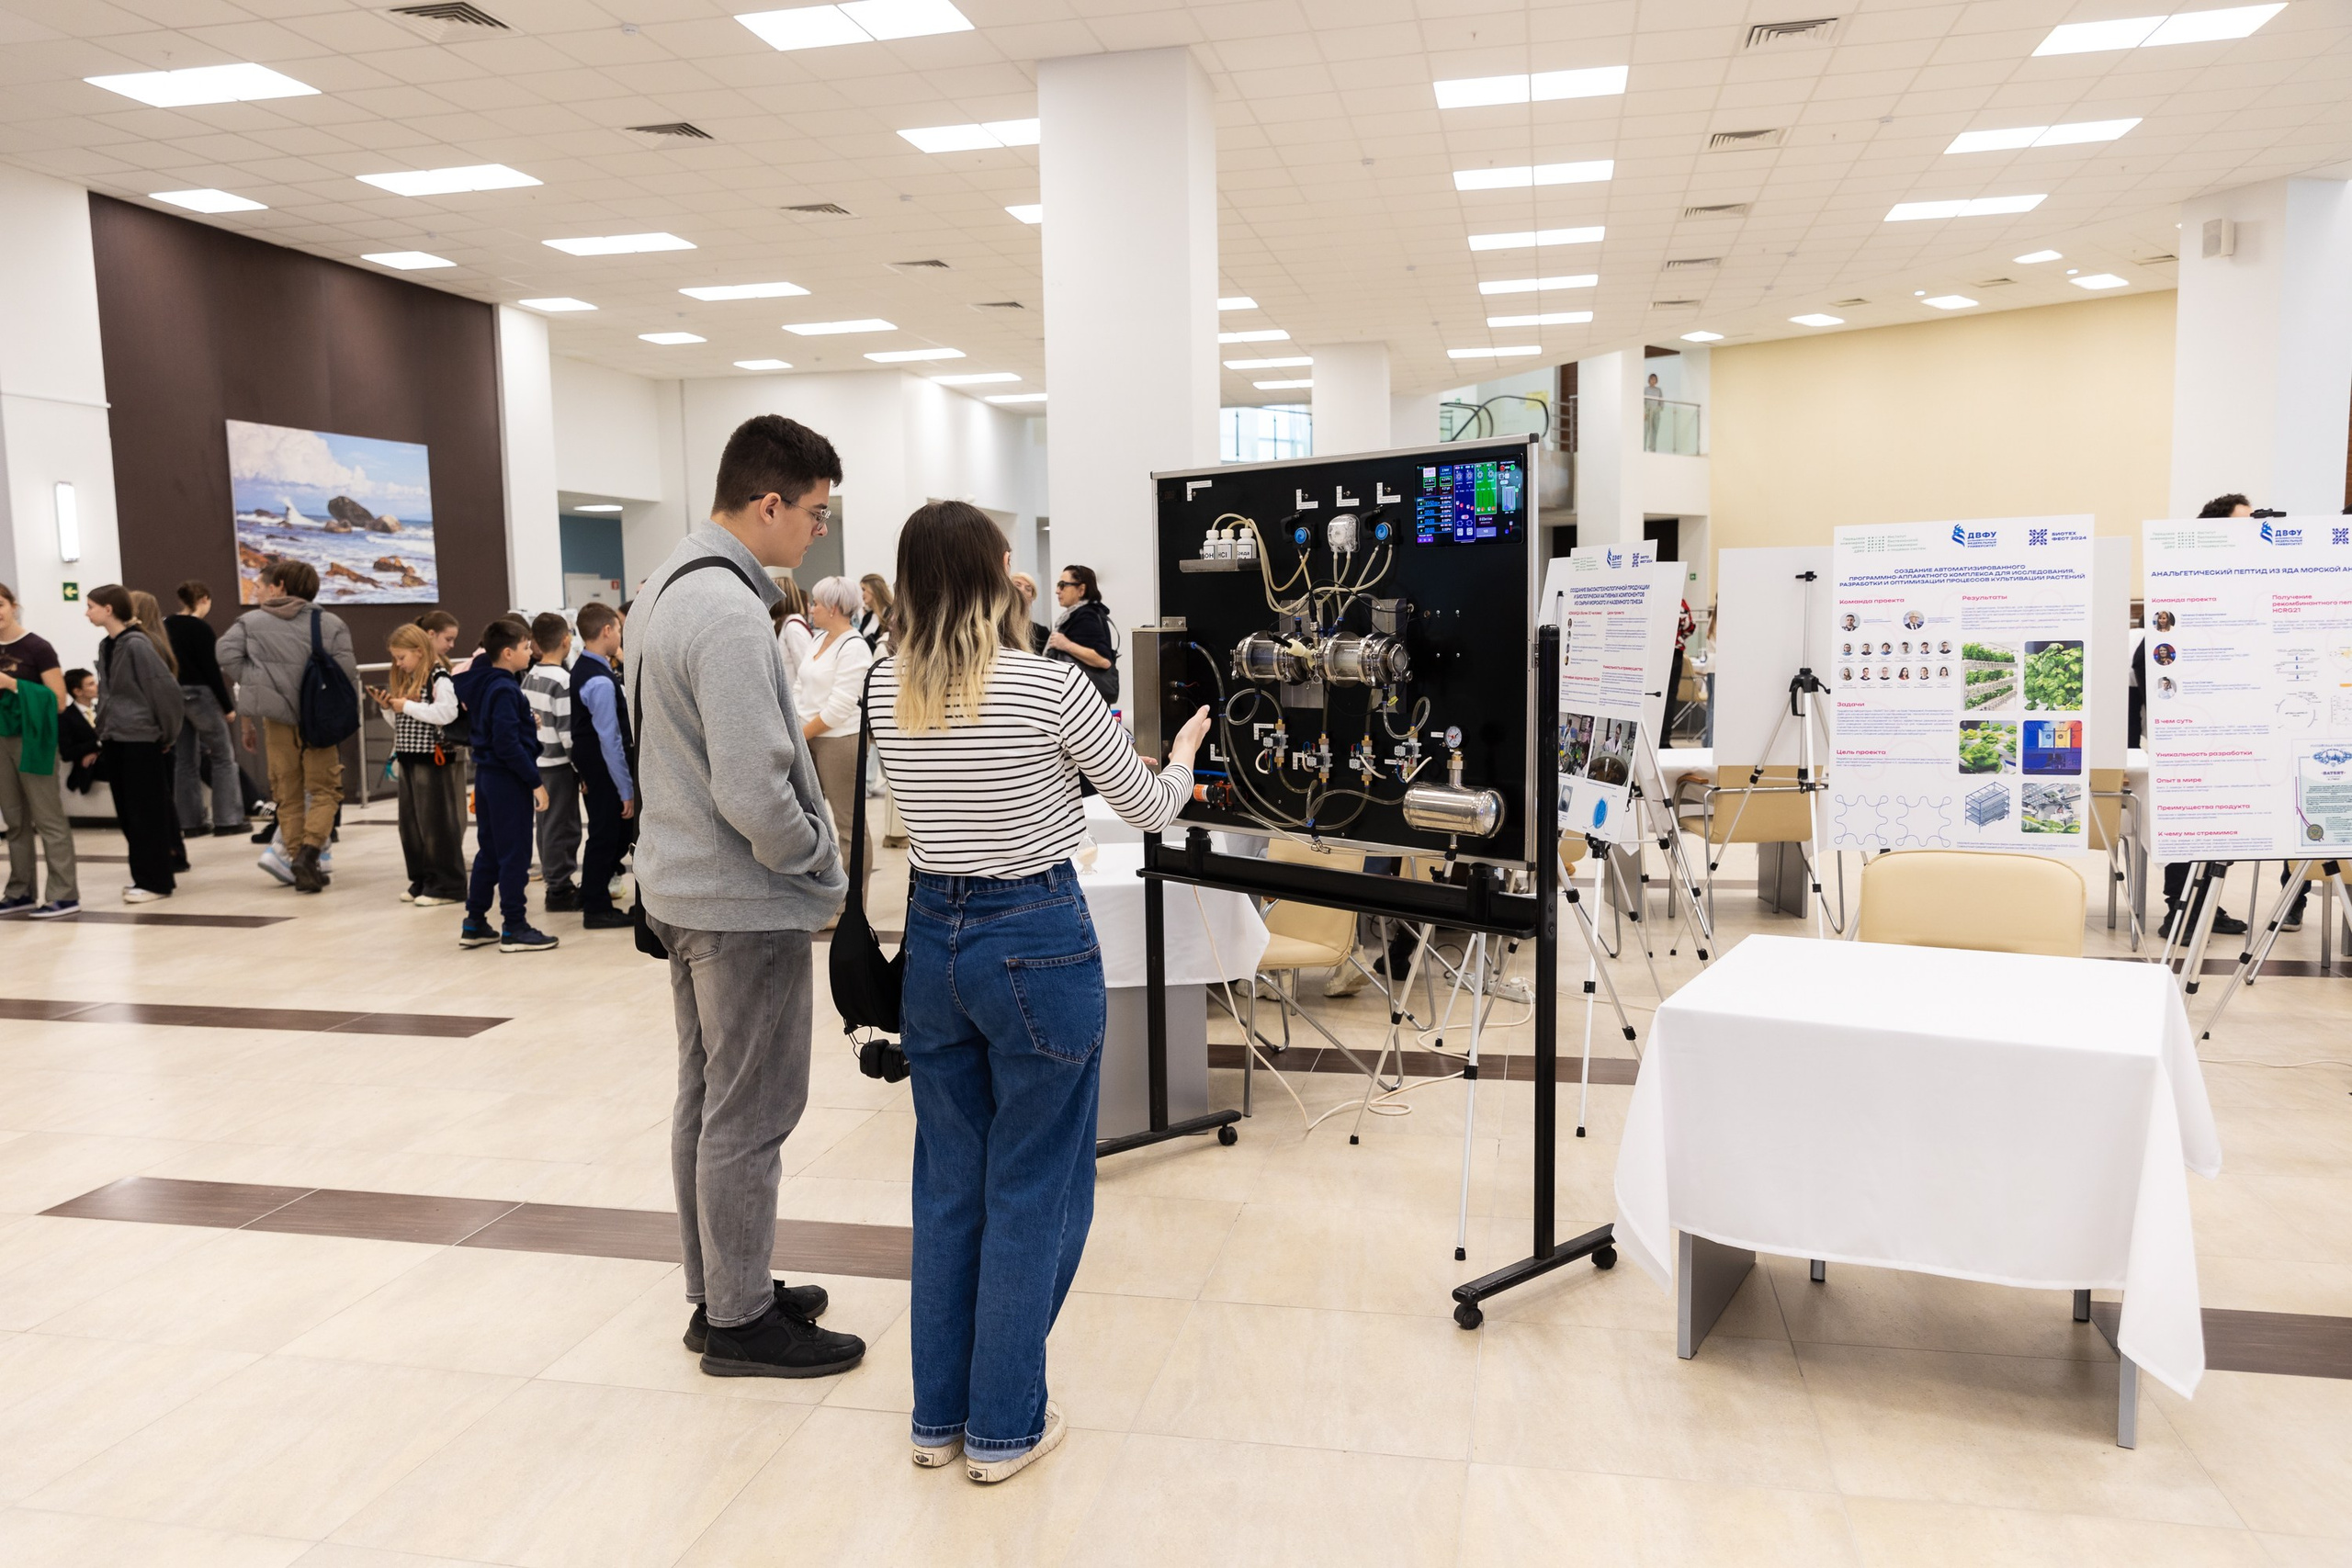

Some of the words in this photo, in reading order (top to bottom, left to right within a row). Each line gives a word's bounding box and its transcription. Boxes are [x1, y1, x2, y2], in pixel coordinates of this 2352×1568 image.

[1967, 531, 1997, 539] ДВФУ
[1934, 564, 2026, 572] АВТОМАТИЗИРОВАННОГО
[2151, 568, 2233, 577] АНАЛЬГЕТИЧЕСКИЙ
[2301, 565, 2341, 573] МОРСКОЙ
[1849, 572, 1948, 581] ПРОГРАММНО-АППАРАТНОГО
[1890, 578, 1945, 586] ОПТИМИЗАЦИИ
